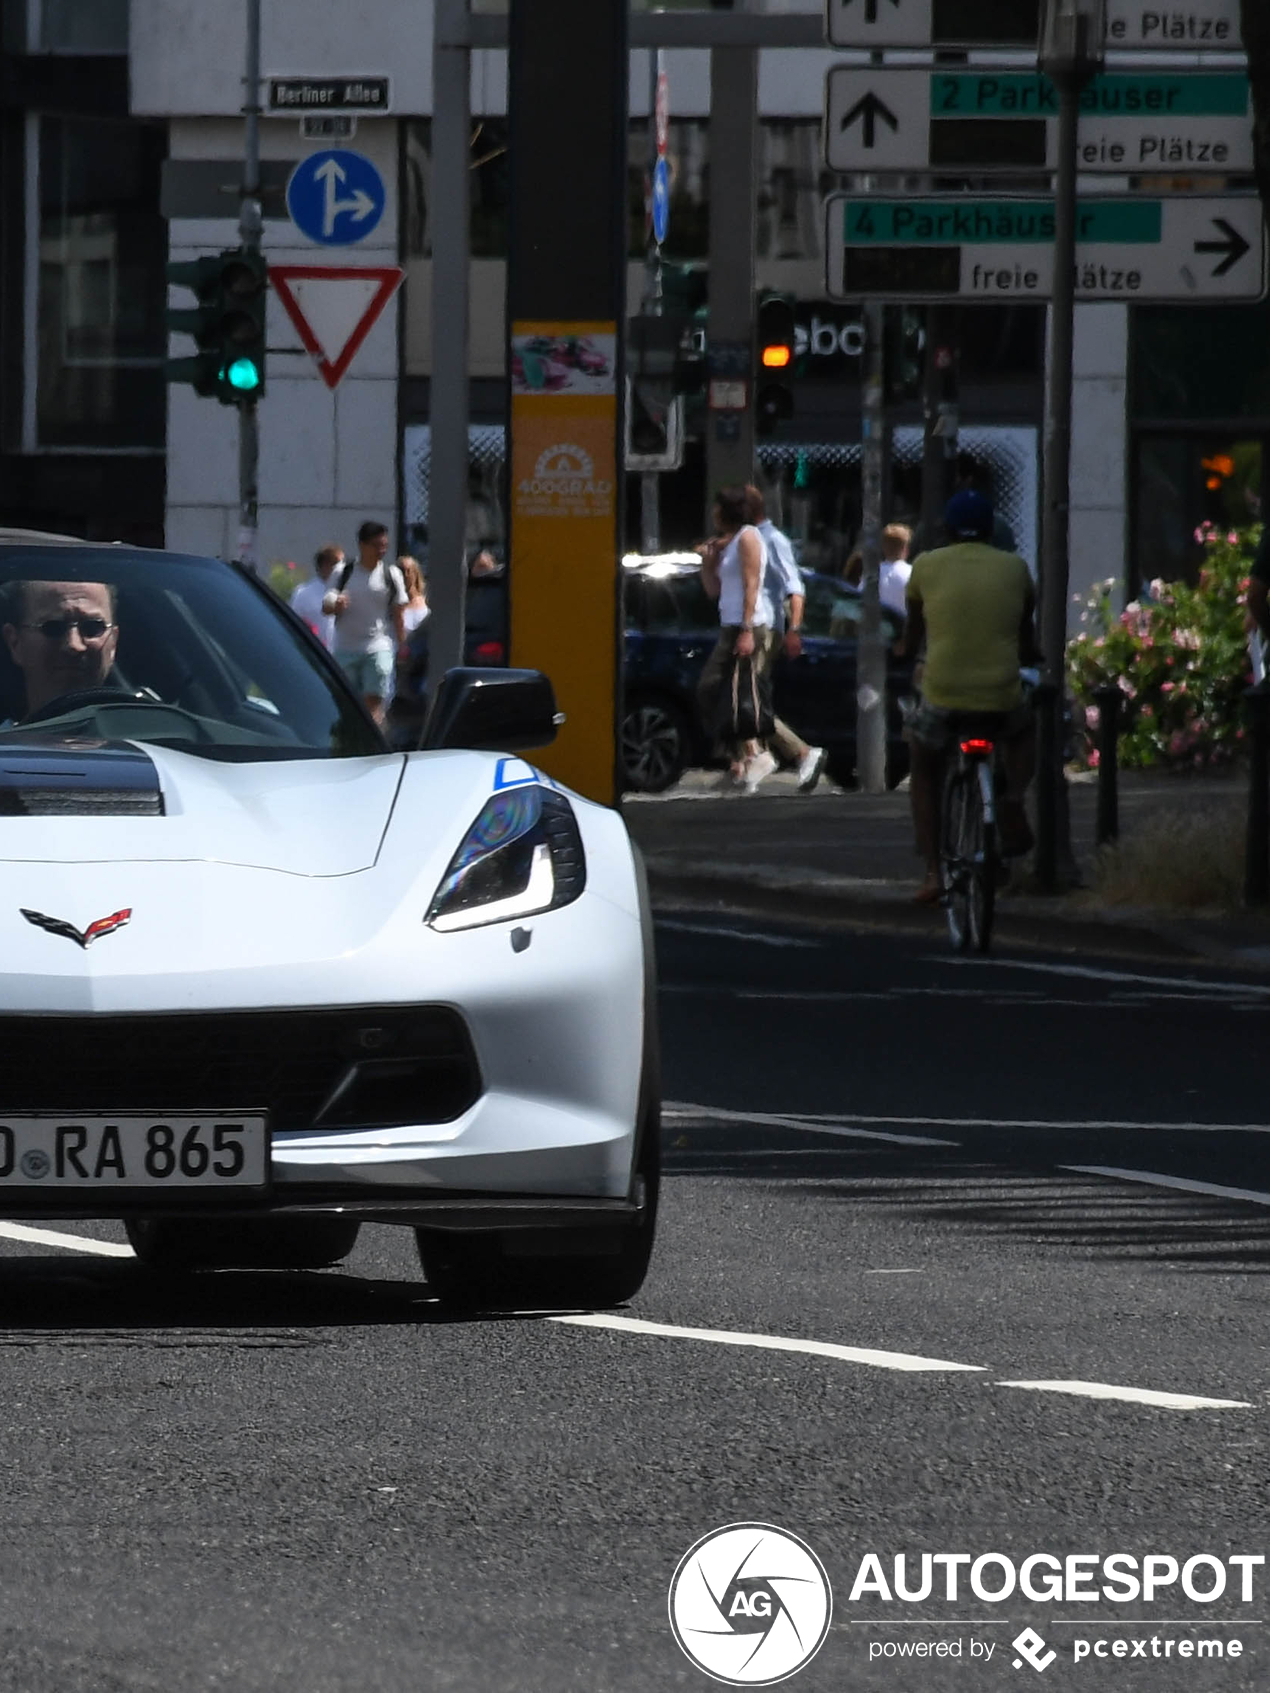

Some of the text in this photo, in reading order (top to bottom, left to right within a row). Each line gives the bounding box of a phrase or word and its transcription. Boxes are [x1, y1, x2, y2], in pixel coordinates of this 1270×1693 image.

[1141, 12, 1230, 40] Plätze
[277, 84, 380, 105] Berliner Allee
[942, 80, 1182, 111] 2 Parkäuser
[1139, 136, 1229, 164] Plätze
[854, 207, 1096, 239] 4 Parkhäusr
[972, 263, 1141, 290] freie lätze
[56, 1125, 126, 1178] RA
[145, 1124, 245, 1178] 865
